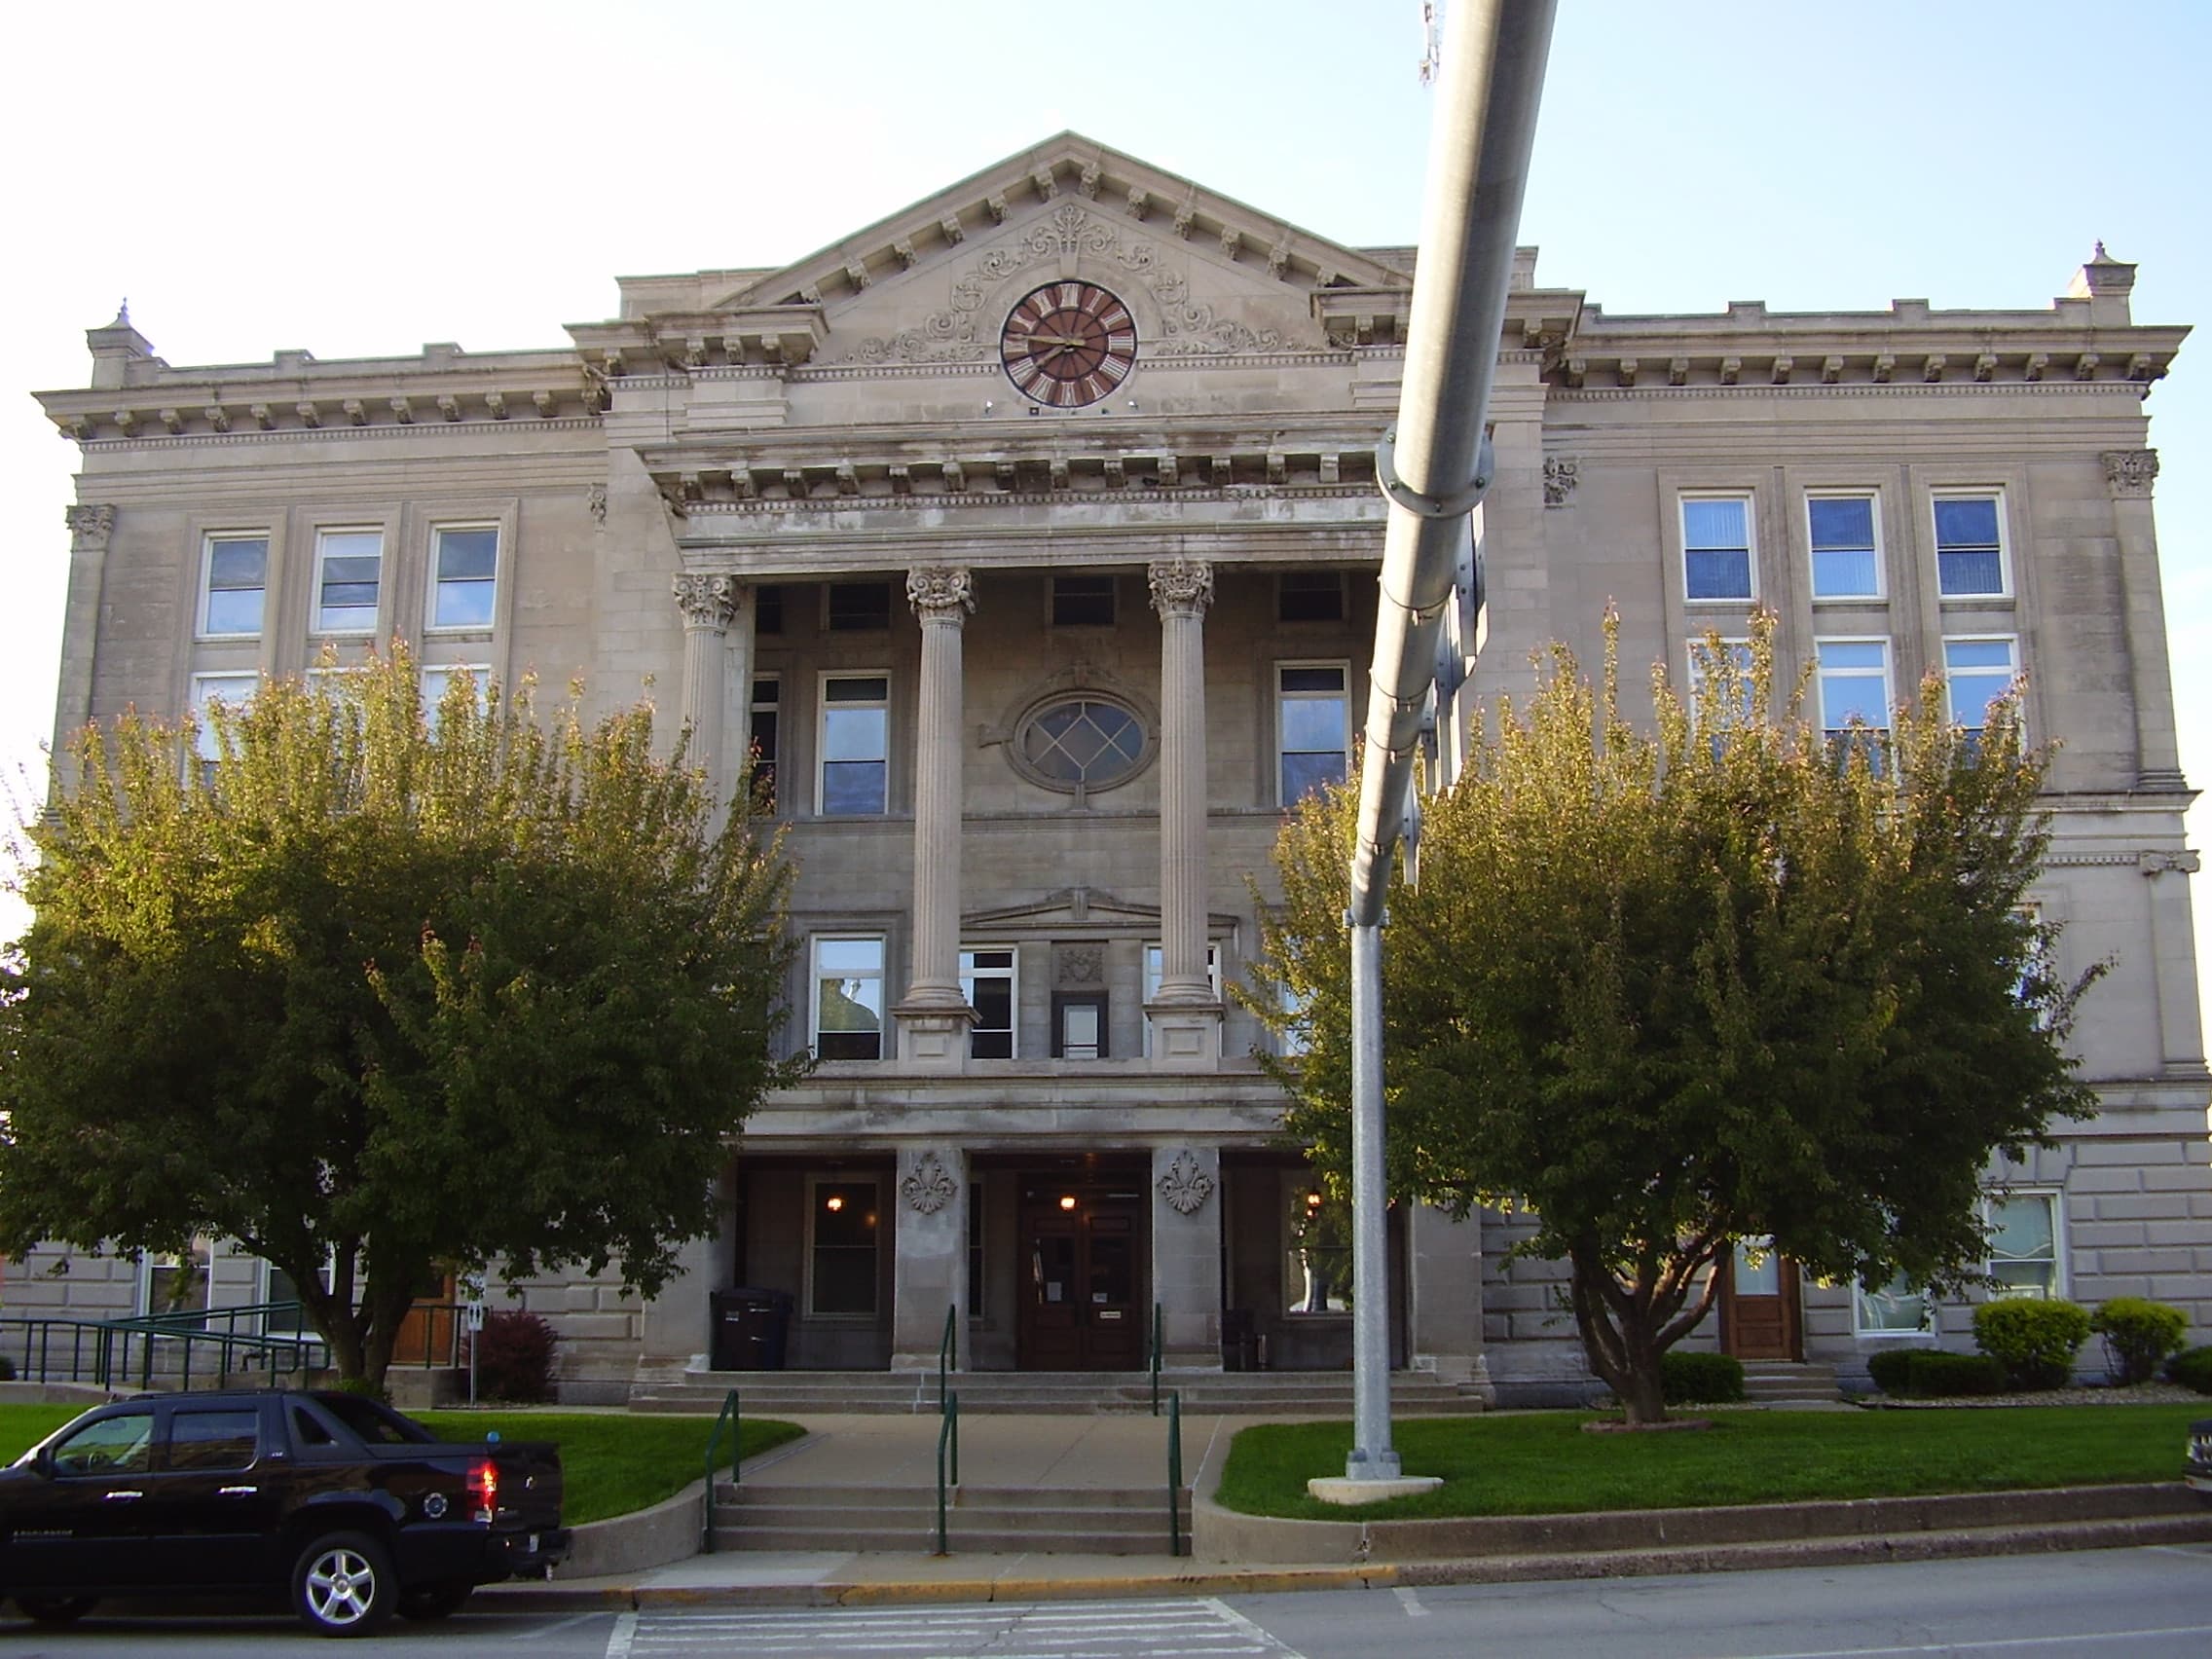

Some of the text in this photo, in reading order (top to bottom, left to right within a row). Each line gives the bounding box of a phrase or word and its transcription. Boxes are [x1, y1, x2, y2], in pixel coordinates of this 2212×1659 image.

[1086, 289, 1105, 313] I
[1010, 310, 1037, 332] X
[1100, 308, 1128, 329] II
[1108, 333, 1134, 351] III
[1085, 375, 1108, 399] V
